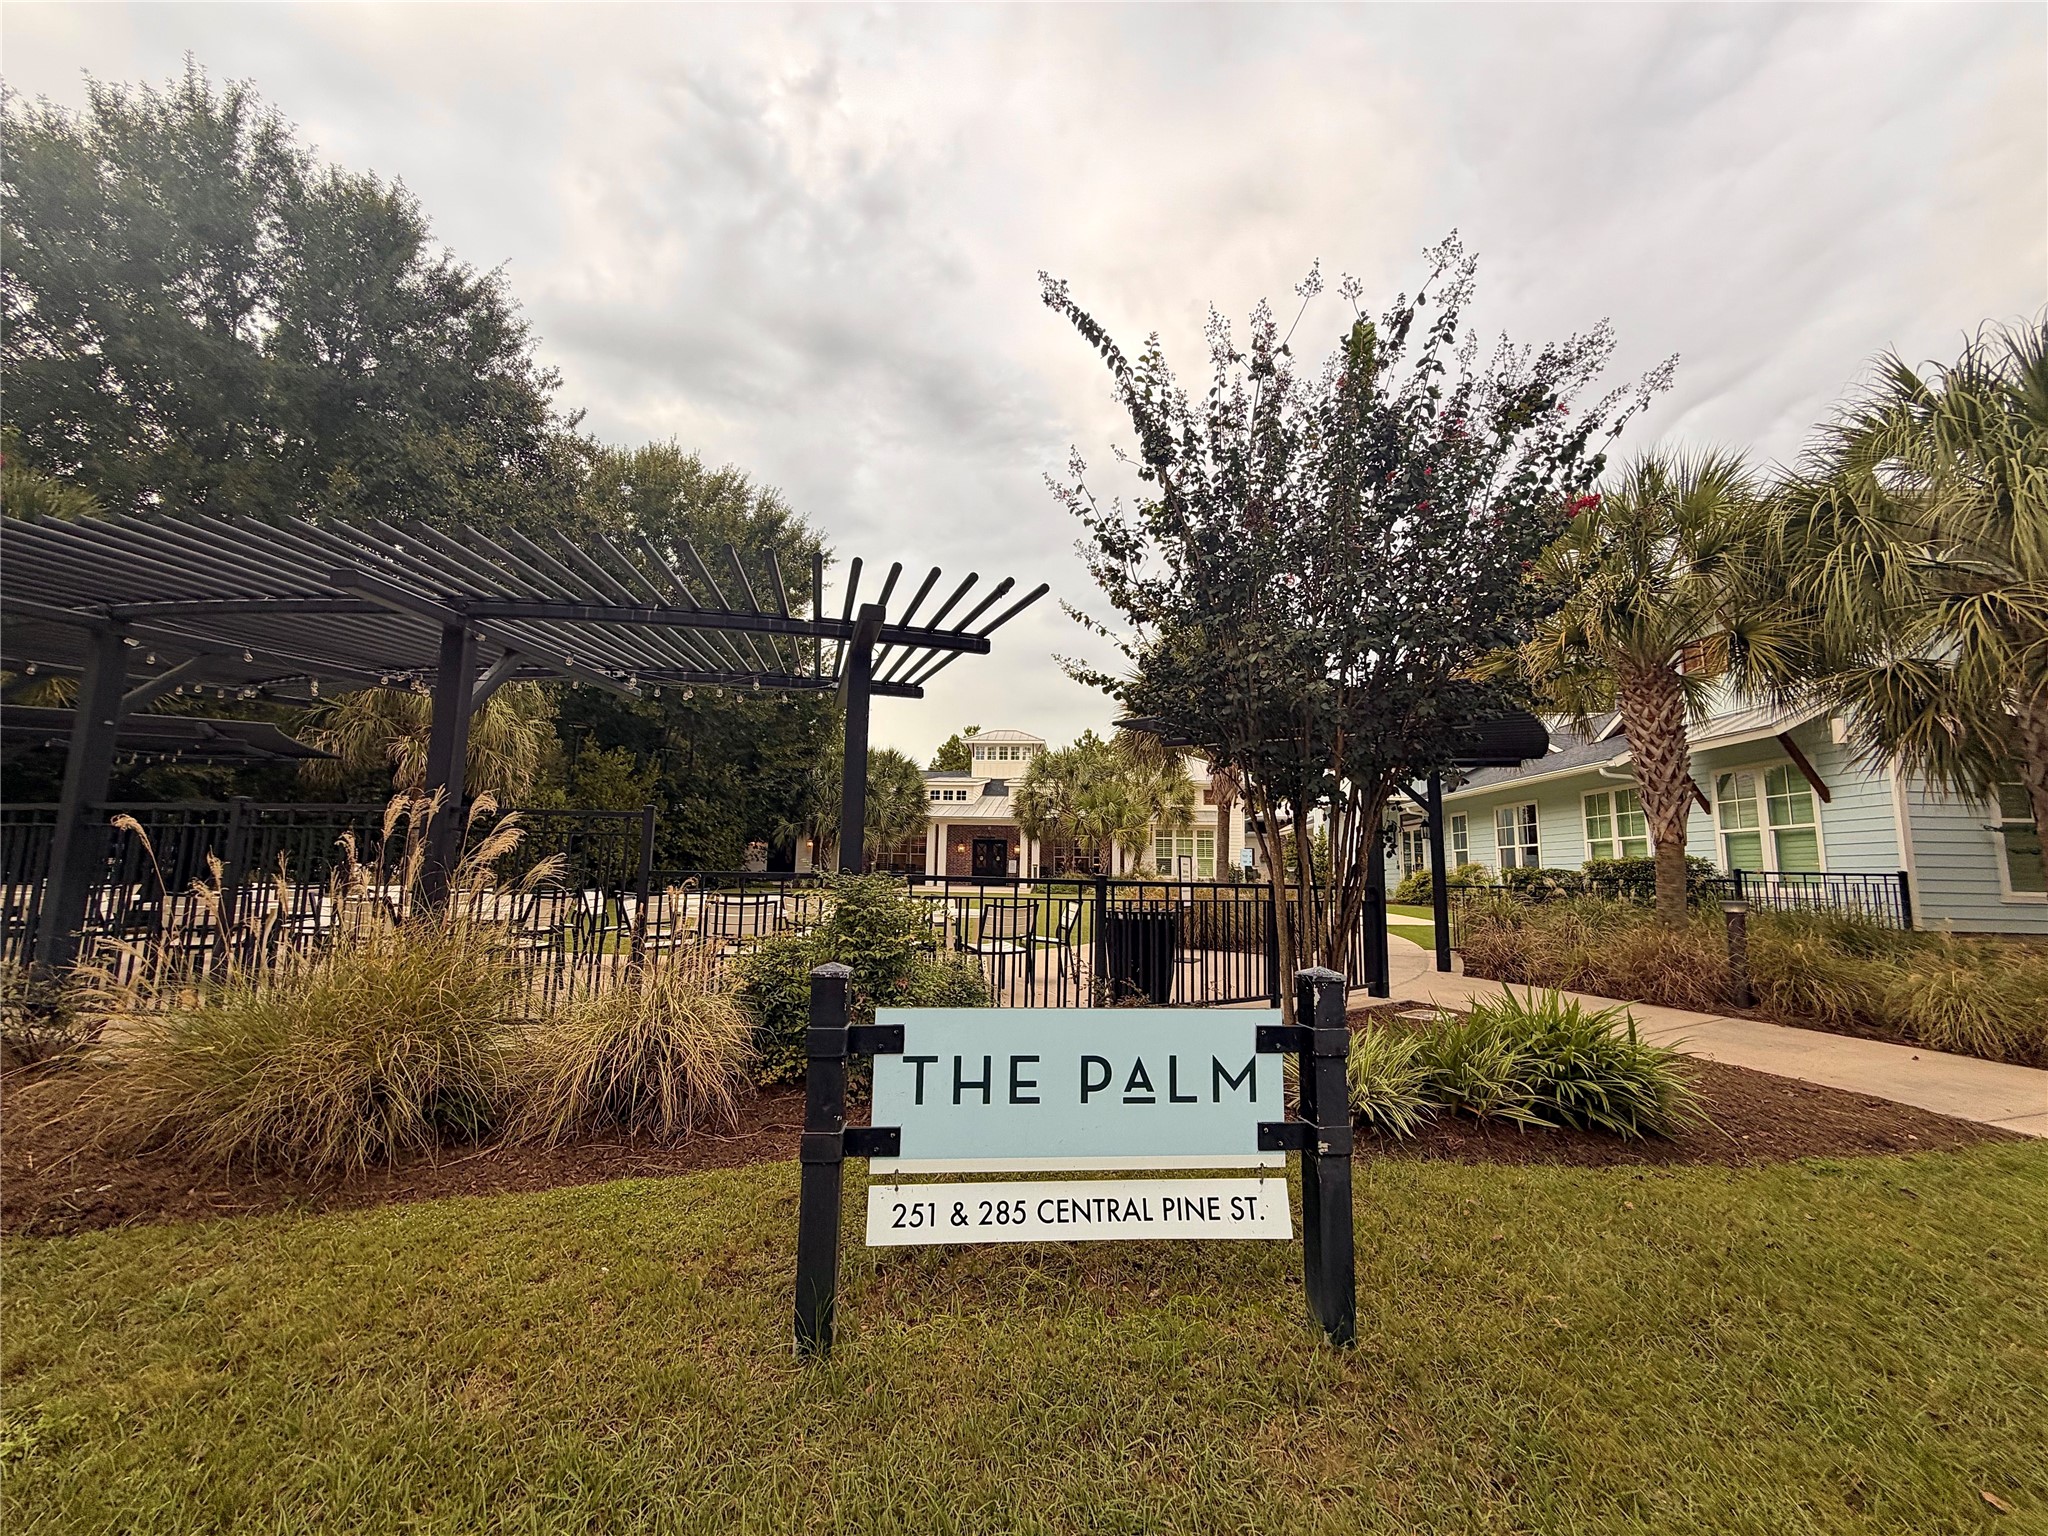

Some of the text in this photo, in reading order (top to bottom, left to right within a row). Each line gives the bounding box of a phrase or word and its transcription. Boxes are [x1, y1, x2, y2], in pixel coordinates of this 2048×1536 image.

[902, 1054, 1257, 1106] THE PALM
[891, 1196, 1265, 1229] 251 & 285 CENTRAL PINE ST.
